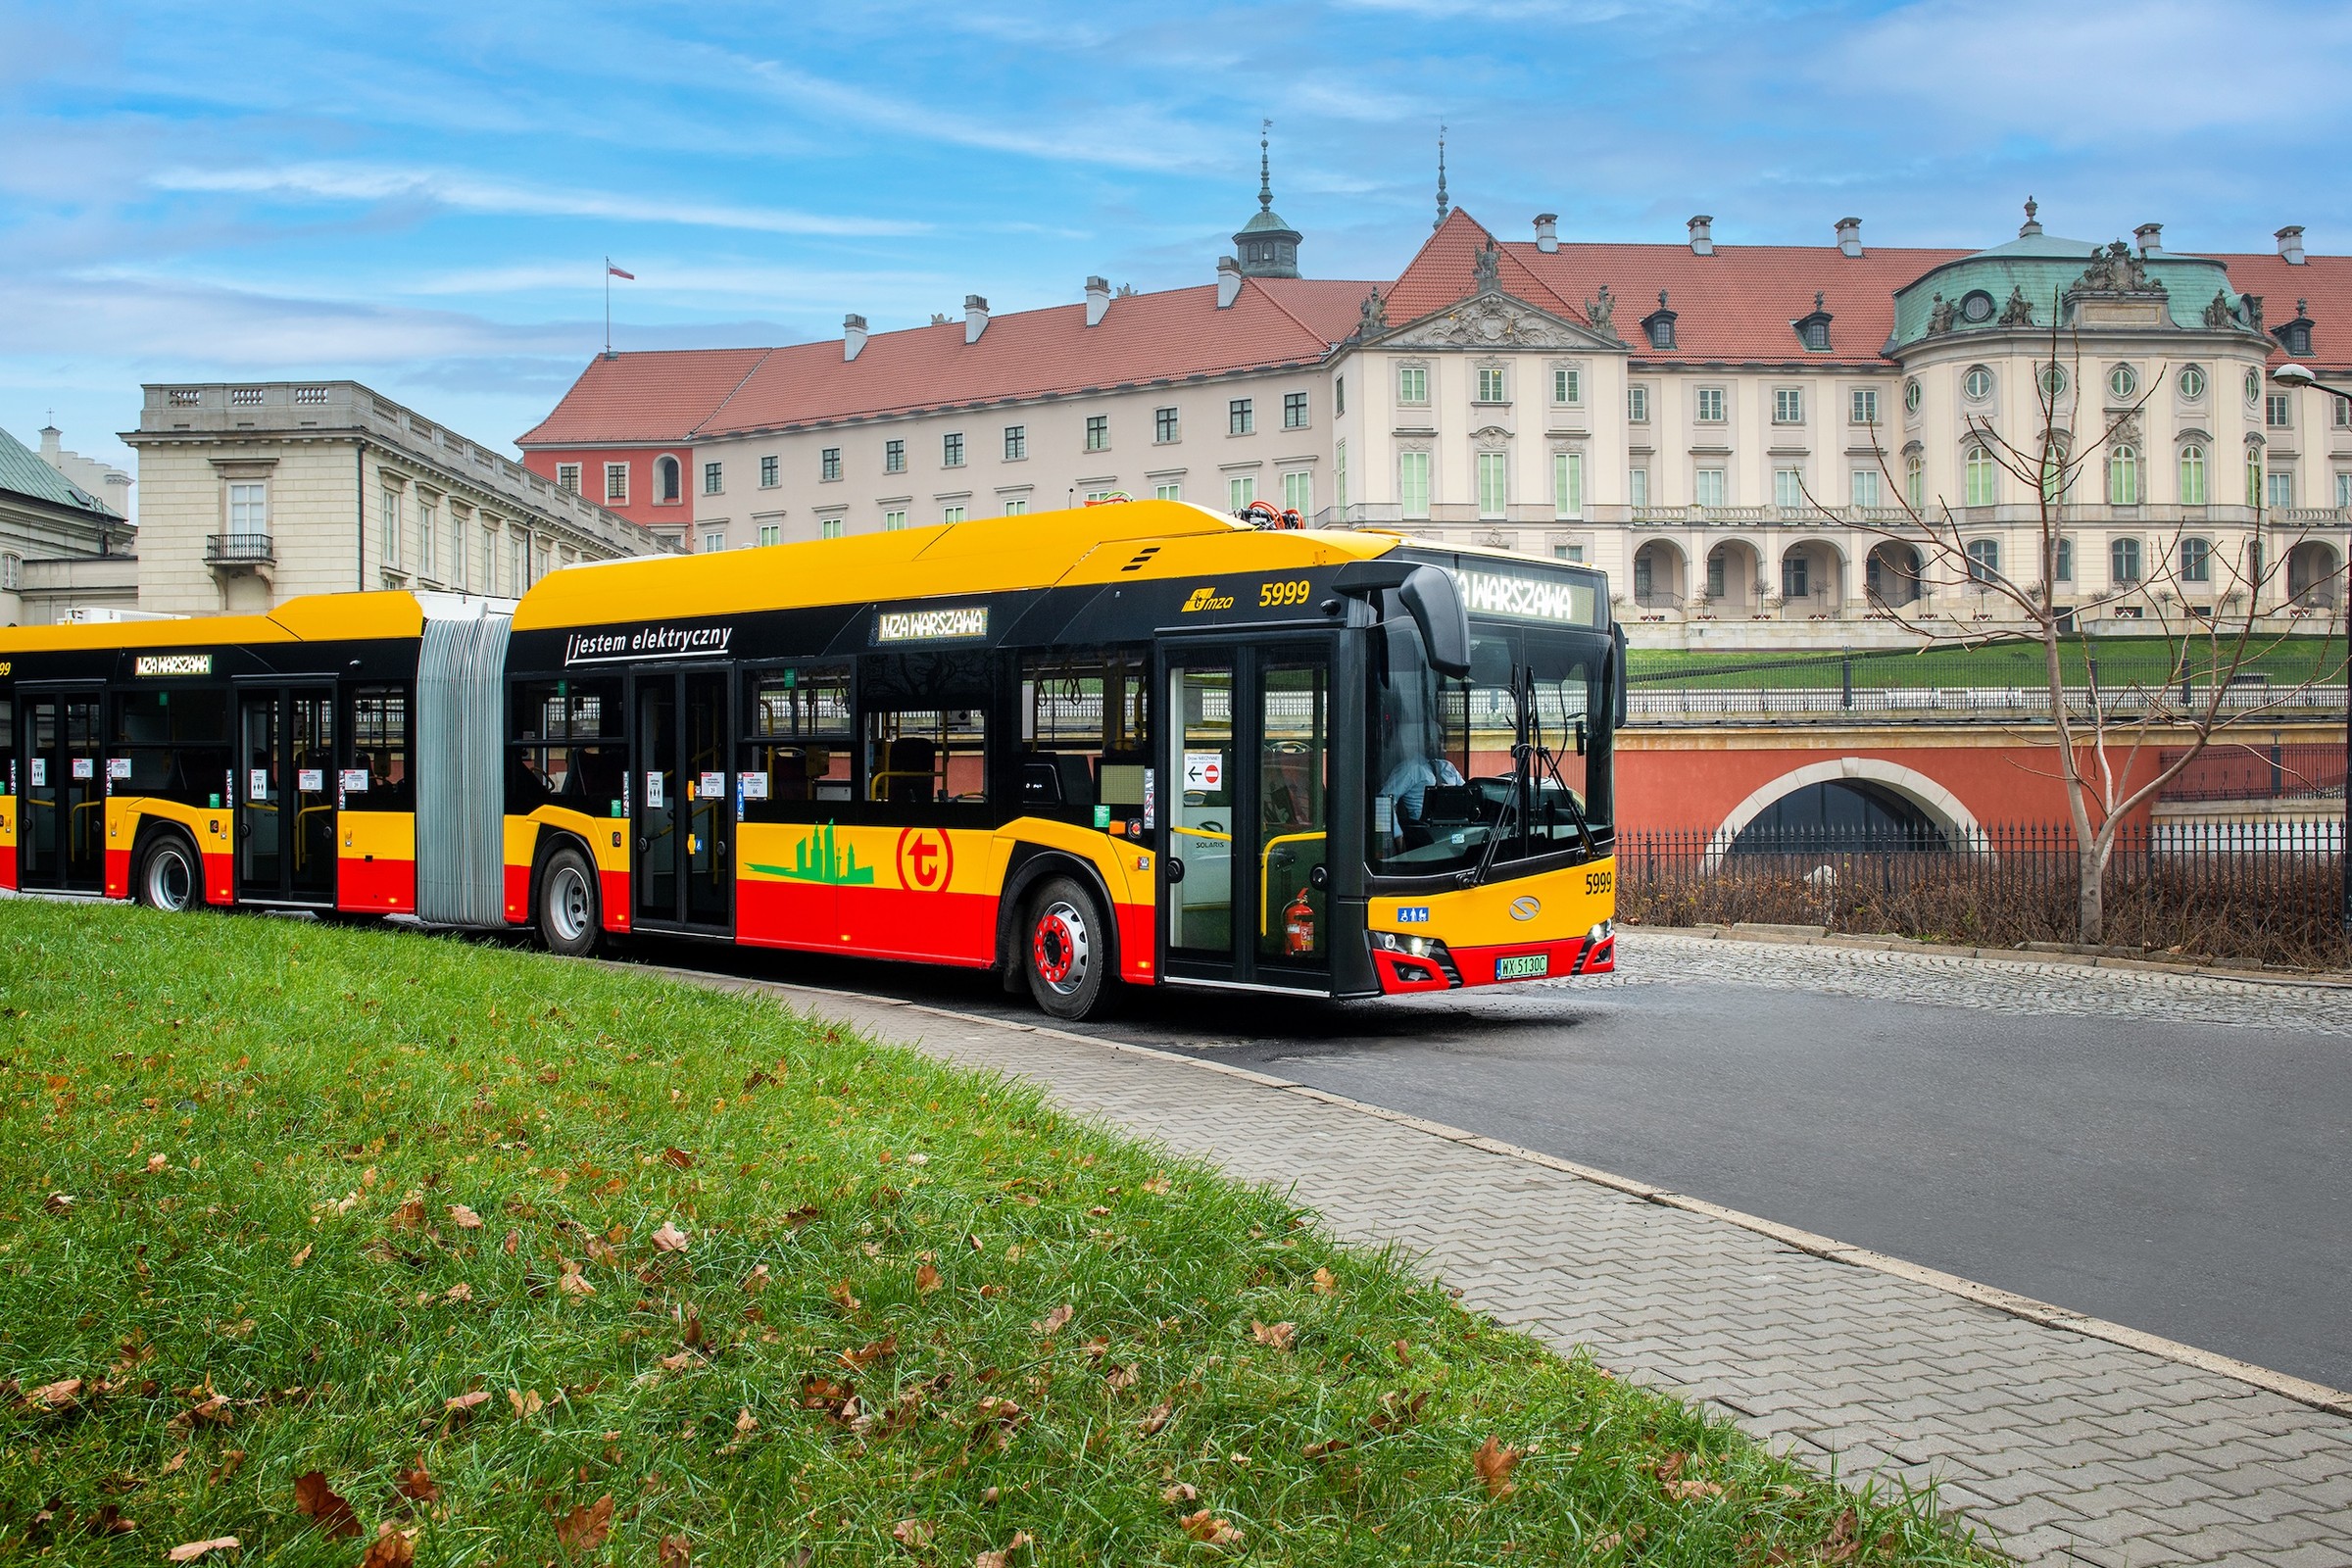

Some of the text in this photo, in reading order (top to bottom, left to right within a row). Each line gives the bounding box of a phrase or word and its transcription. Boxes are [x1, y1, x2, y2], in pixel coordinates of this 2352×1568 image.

[1203, 596, 1234, 611] mza
[1258, 579, 1310, 608] 5999
[1471, 574, 1572, 620] WARSZAWA
[882, 610, 983, 638] MZA WARSZAWA
[572, 626, 733, 660] jestem elektryczny
[137, 655, 209, 674] MZA WARSZAWA
[1585, 871, 1612, 896] 5999
[1502, 956, 1545, 975] WX 5130C
